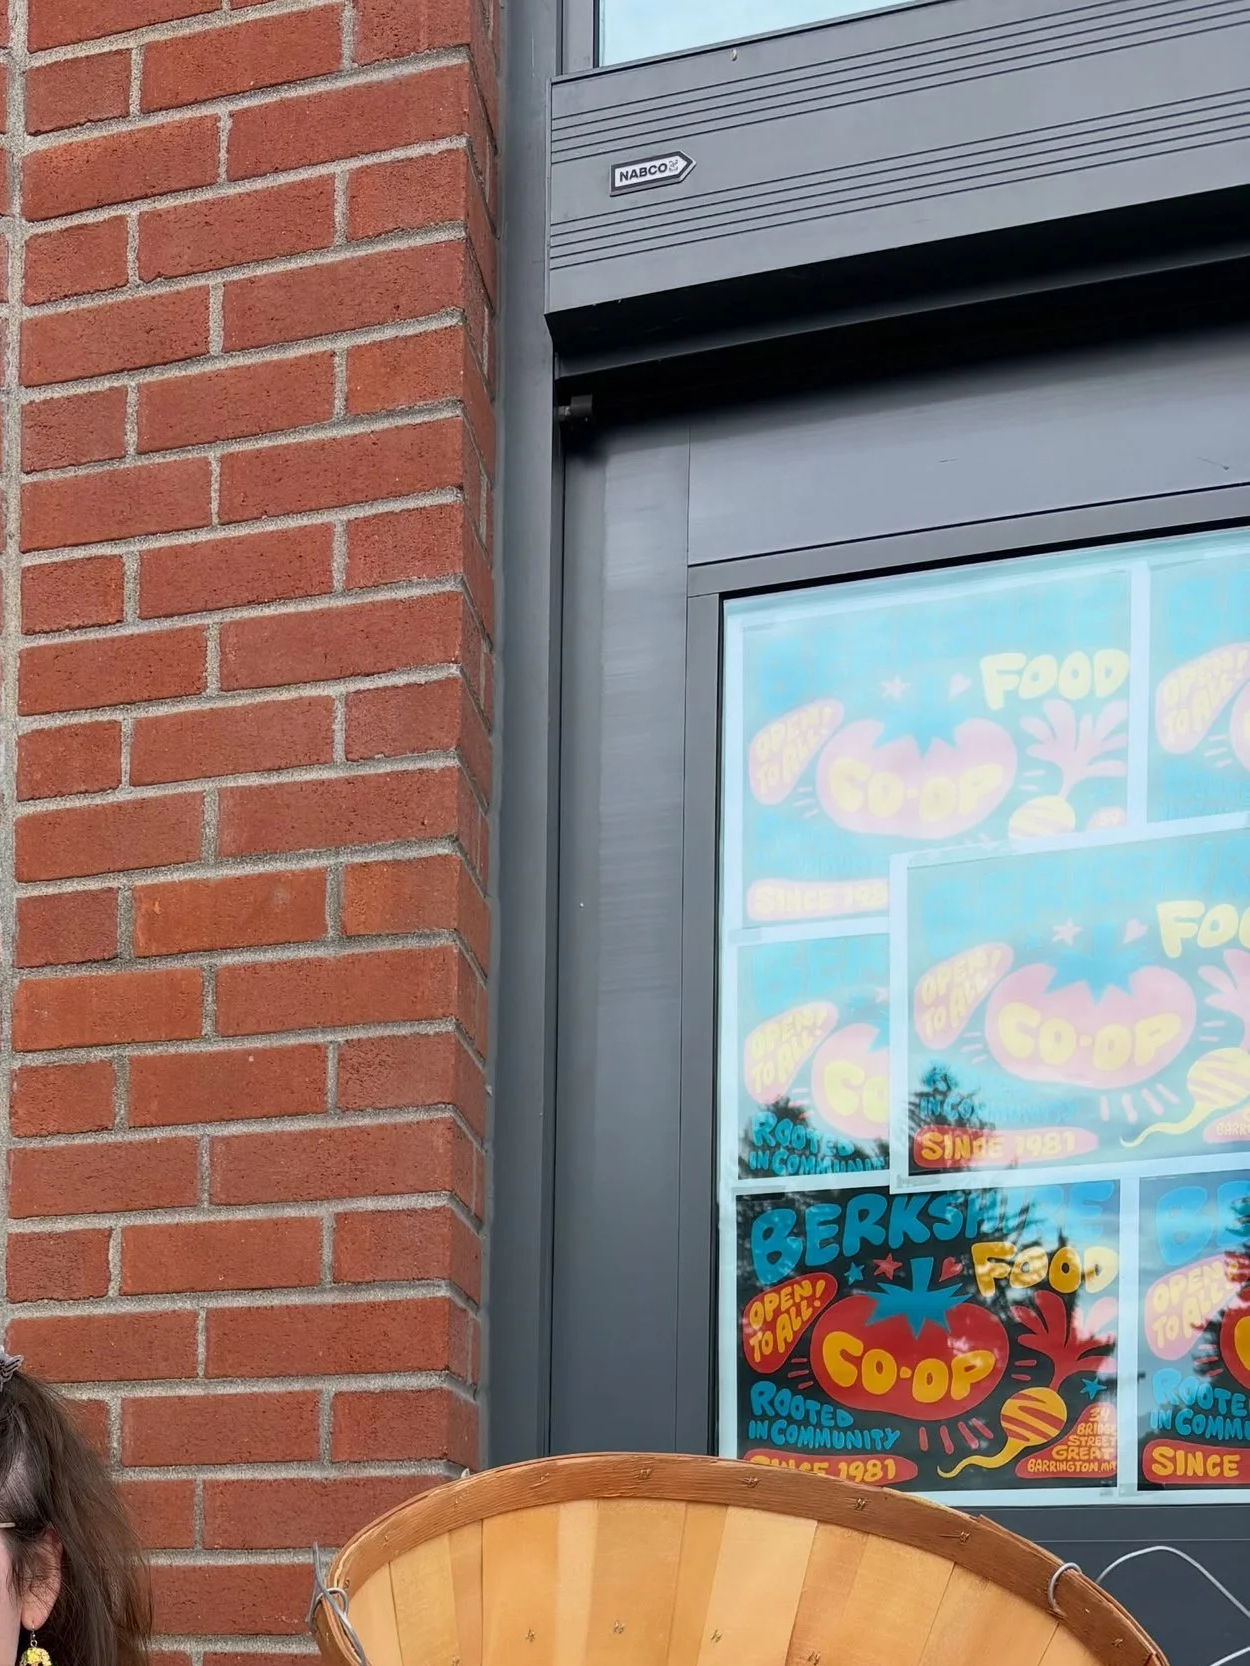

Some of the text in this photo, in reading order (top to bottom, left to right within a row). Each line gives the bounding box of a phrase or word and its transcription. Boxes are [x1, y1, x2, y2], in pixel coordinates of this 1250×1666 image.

[619, 163, 668, 182] NABCO
[980, 649, 1129, 710] FOOD
[1156, 900, 1250, 958] FO
[923, 1007, 946, 1039] TO
[998, 1002, 1181, 1071] CO-OP
[751, 1061, 774, 1093] TO
[752, 1111, 854, 1156] ROOTED
[921, 1131, 1075, 1161] SINCE 1981
[772, 1148, 889, 1177] COMMUNIT
[751, 1182, 1115, 1286] BERKSHIRE
[972, 1241, 1119, 1297] FOOD
[750, 1331, 773, 1363] TO
[1152, 1315, 1177, 1348] TO
[822, 1331, 995, 1403] CO-OP
[750, 1381, 854, 1427] ROOTED
[1152, 1368, 1250, 1417] ROOTE
[748, 1419, 900, 1450] IN COMMUNITY
[1052, 1446, 1115, 1461] GREAT
[1151, 1447, 1240, 1478] SINCE
[838, 1458, 896, 1483] 1981
